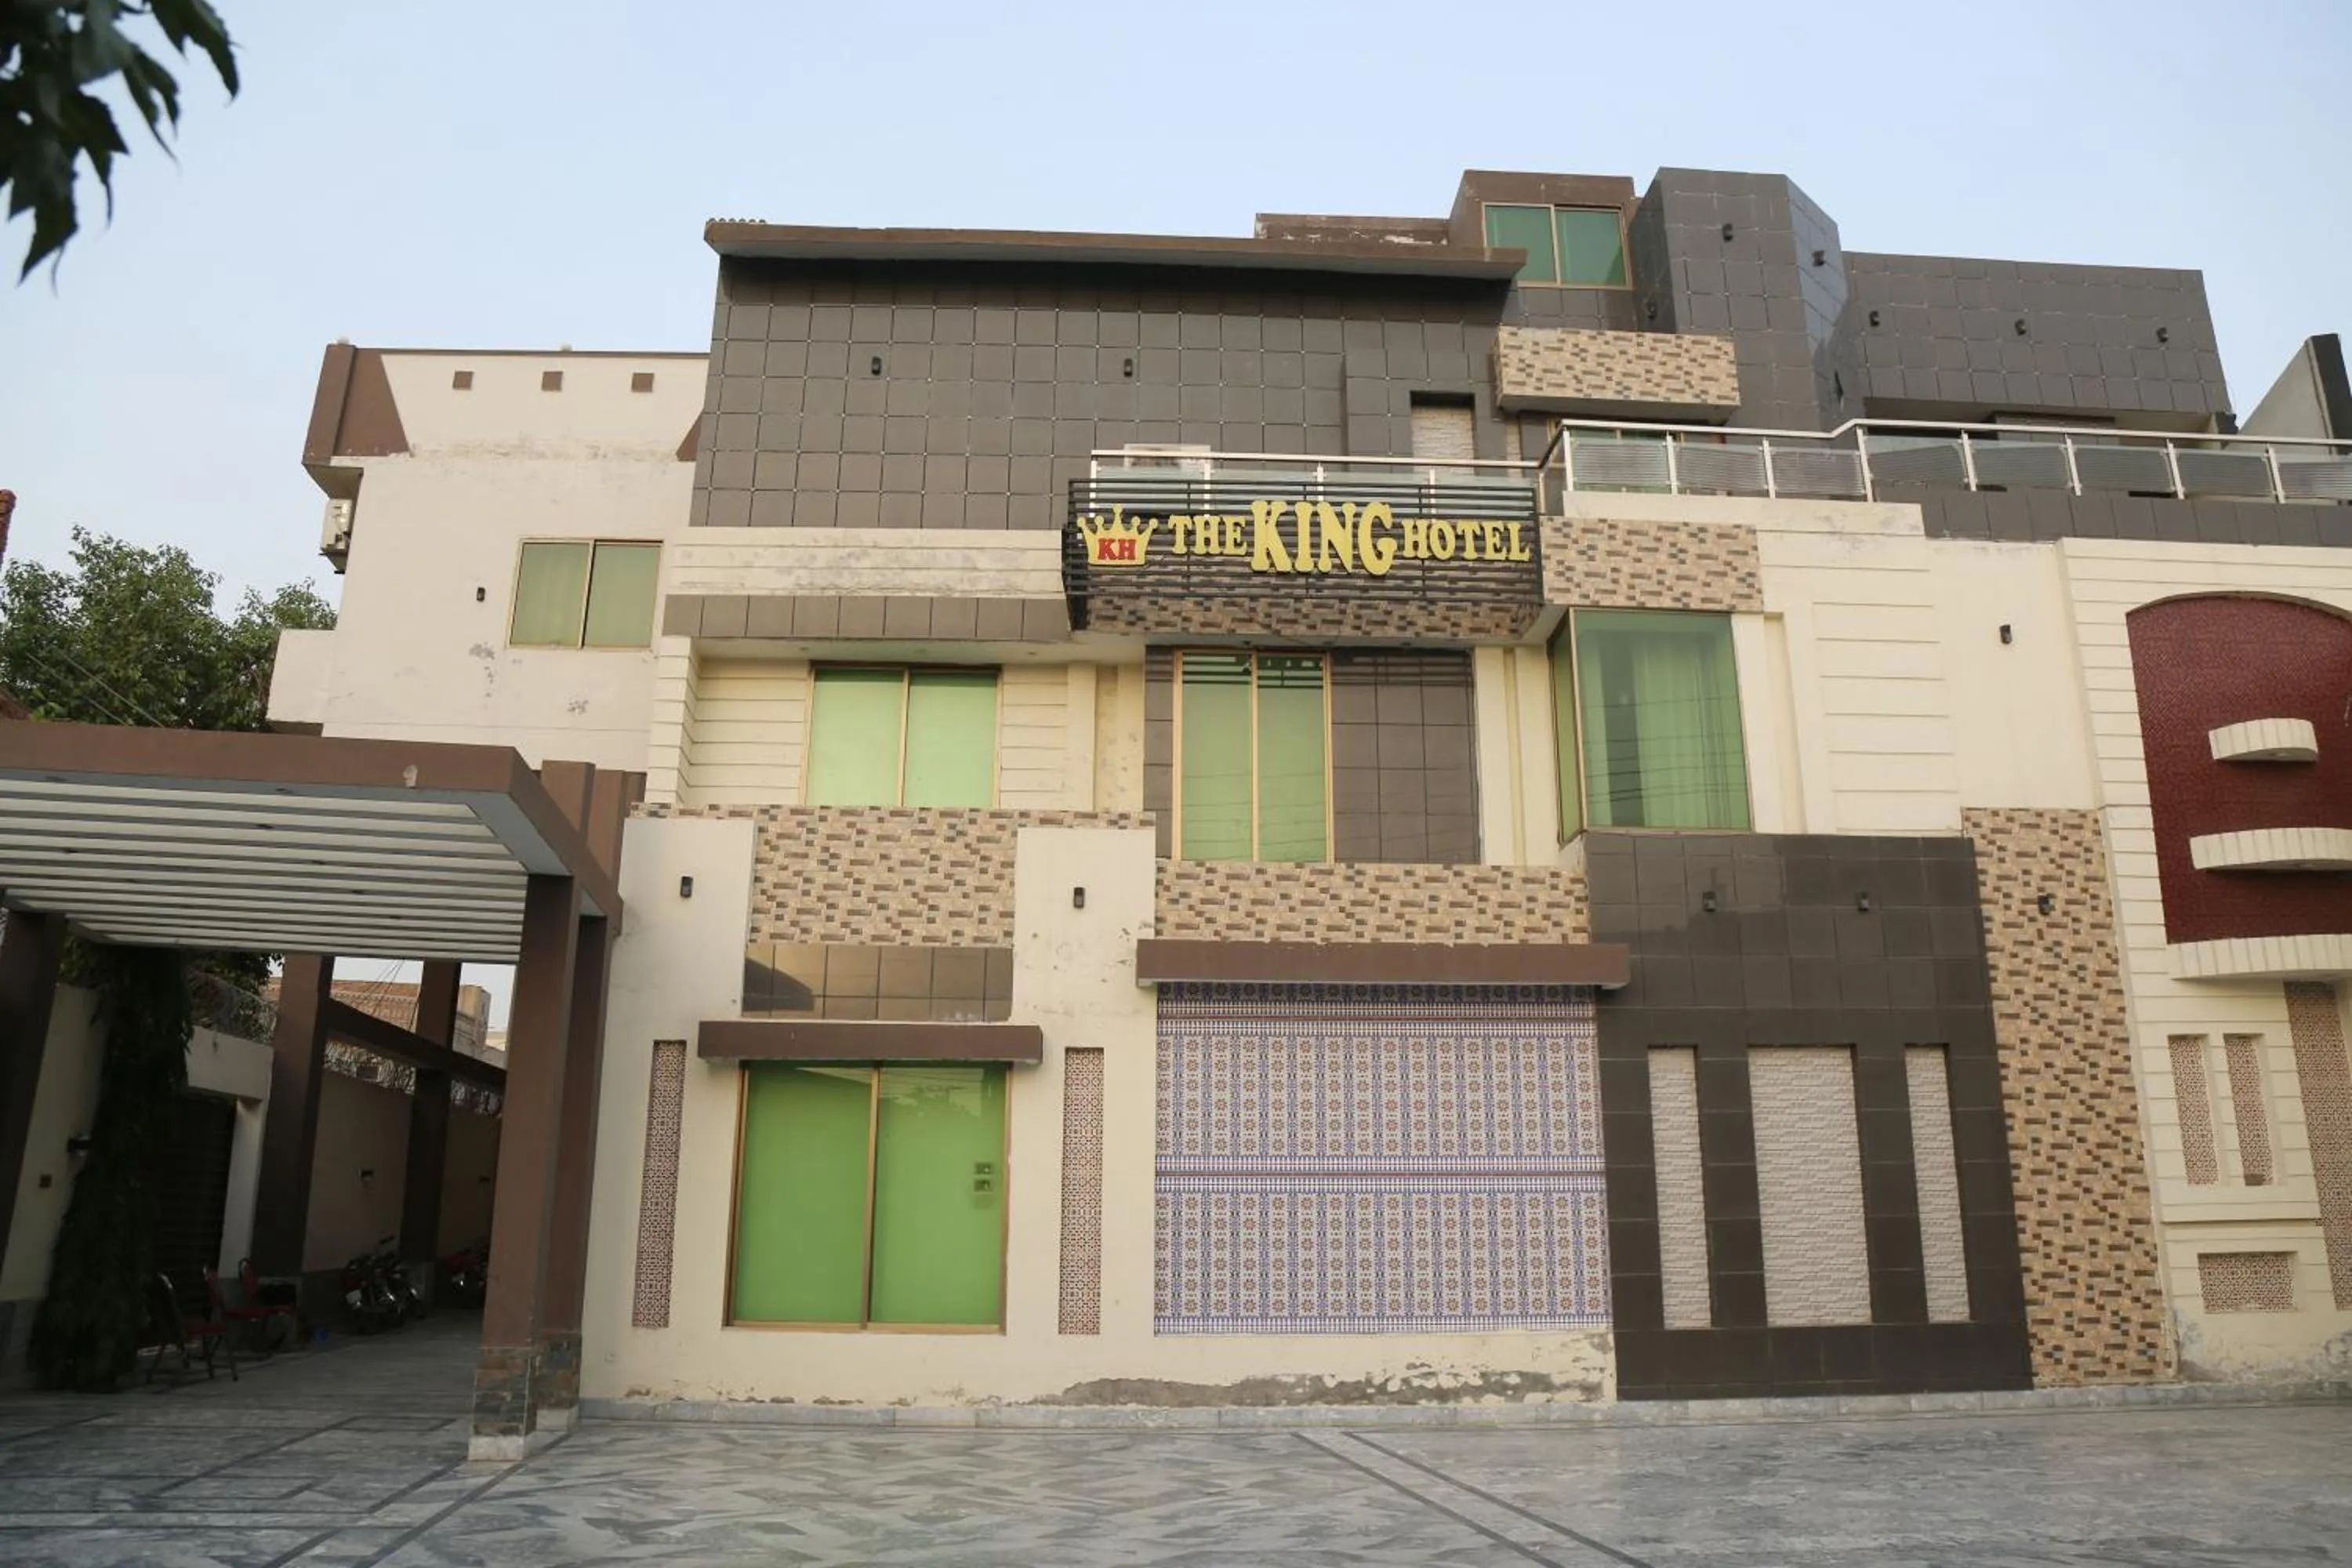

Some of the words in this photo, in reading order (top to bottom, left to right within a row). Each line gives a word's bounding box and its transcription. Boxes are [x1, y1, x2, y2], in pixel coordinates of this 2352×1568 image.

[1098, 537, 1137, 561] KH
[1167, 514, 1247, 555] THE
[1250, 500, 1398, 575] KING
[1402, 519, 1530, 561] HOTEL
